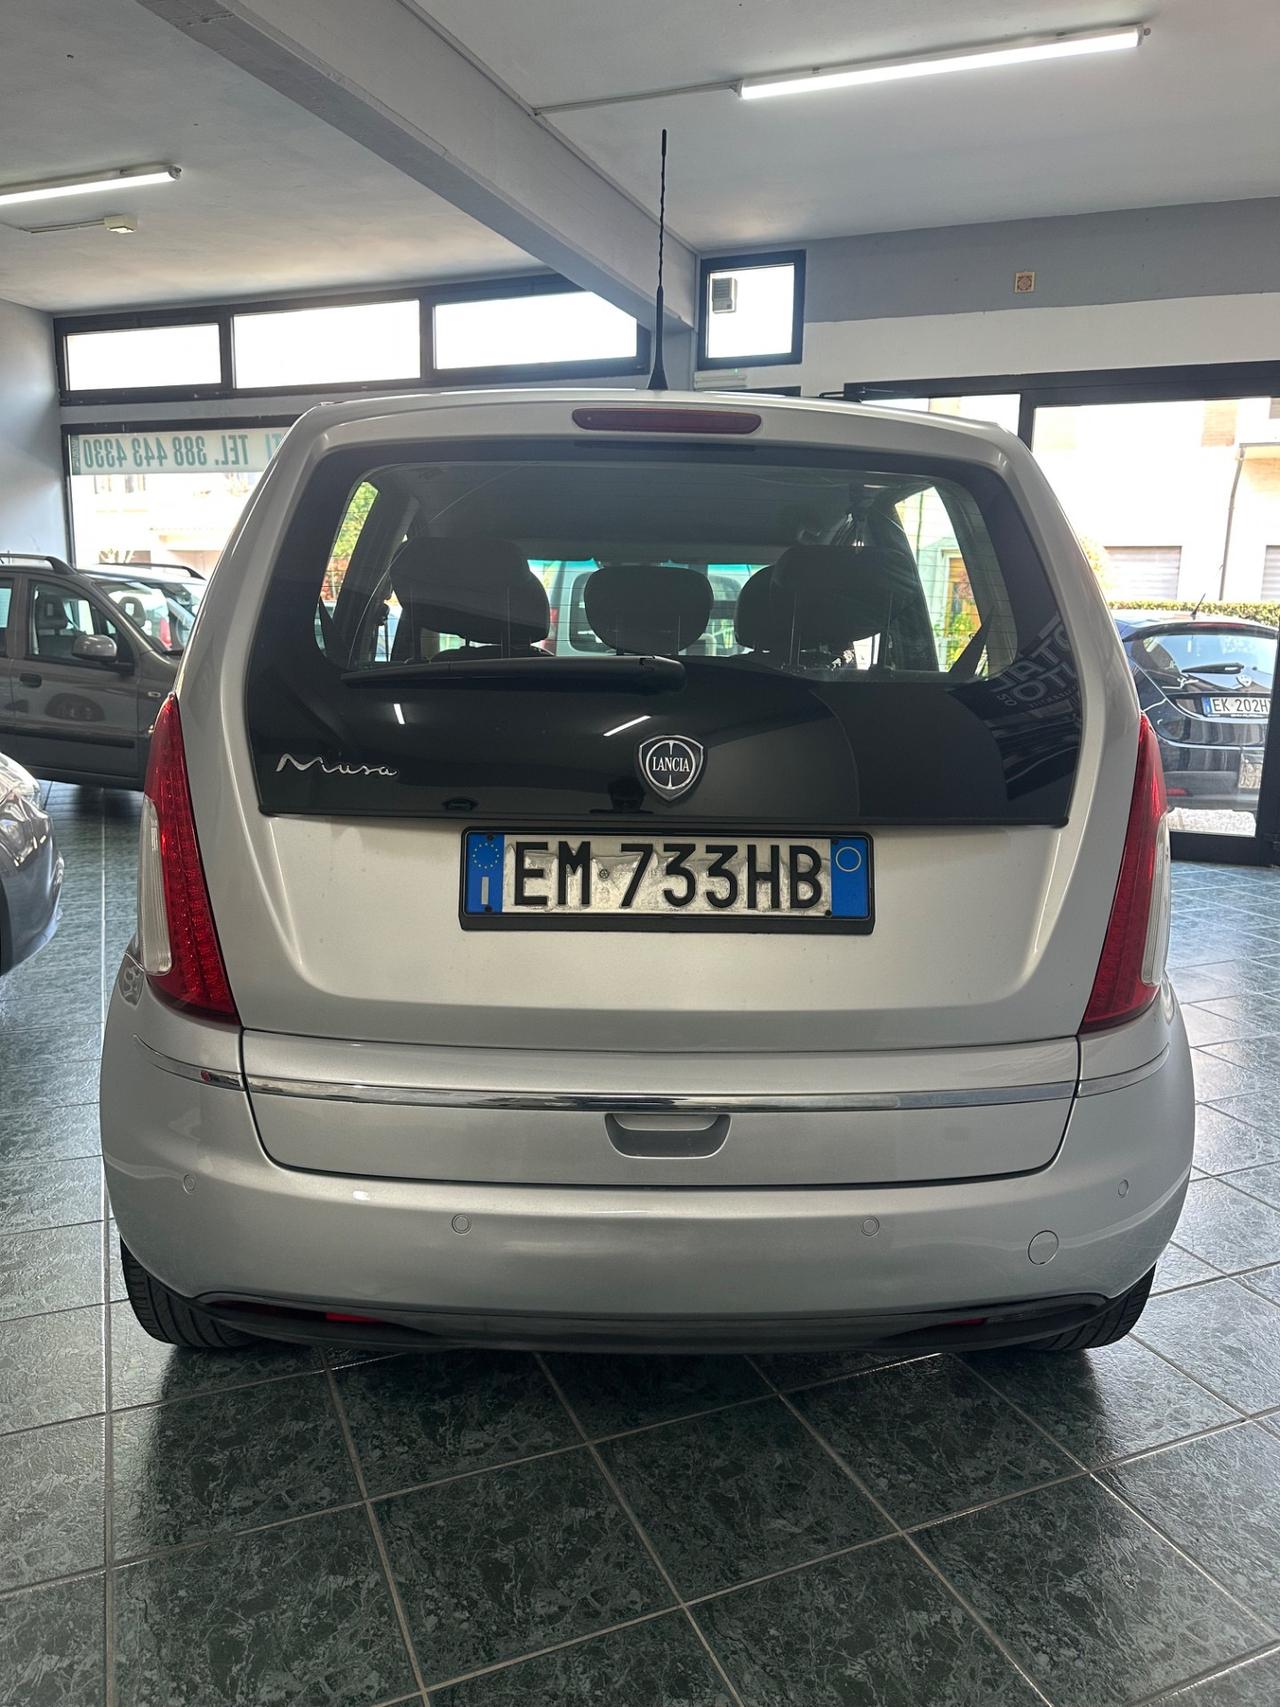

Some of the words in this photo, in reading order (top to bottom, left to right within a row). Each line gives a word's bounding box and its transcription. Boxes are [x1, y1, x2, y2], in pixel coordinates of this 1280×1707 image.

[1212, 698, 1230, 712] EK
[1234, 698, 1271, 712] 202H
[652, 756, 690, 772] LANCIA
[513, 841, 592, 908] EM
[620, 843, 824, 909] 733HB
